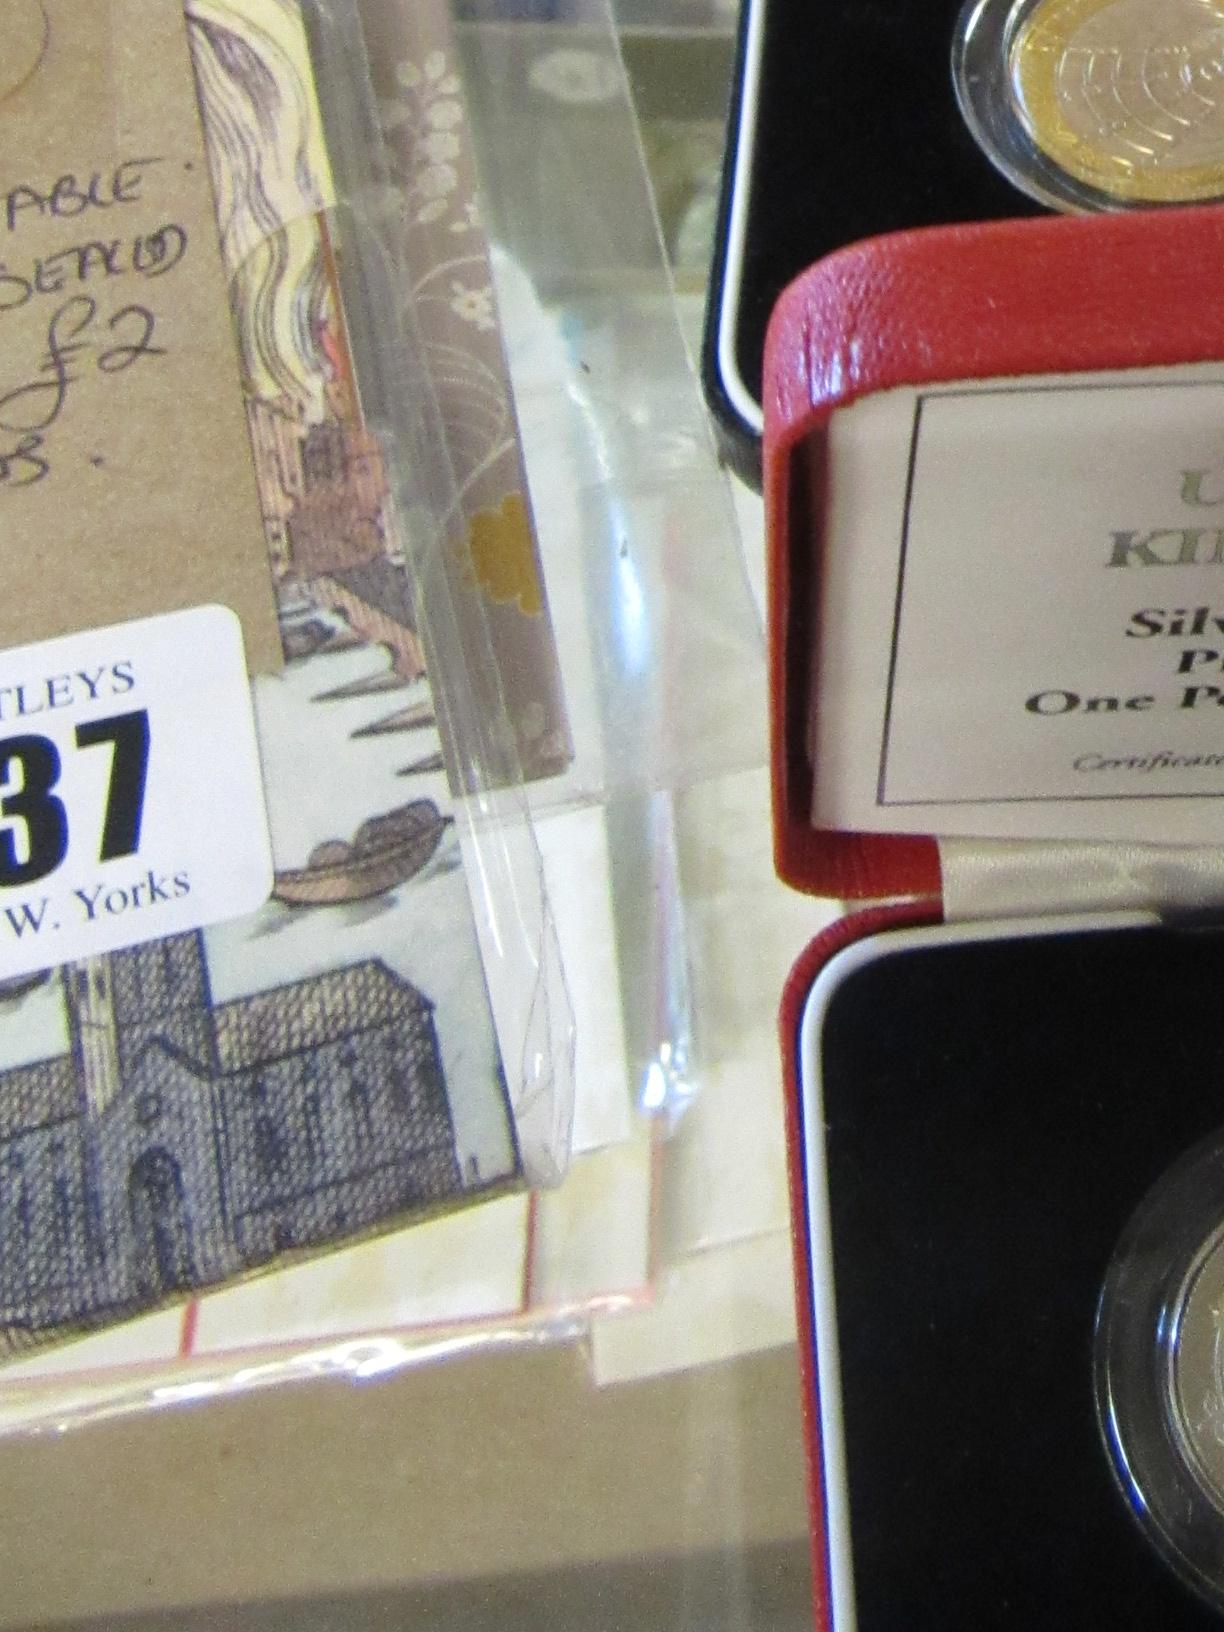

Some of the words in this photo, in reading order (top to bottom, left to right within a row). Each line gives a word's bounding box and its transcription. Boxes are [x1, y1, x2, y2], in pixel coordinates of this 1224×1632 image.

[1024, 688, 1157, 716] One
[3, 900, 61, 941] W.
[73, 869, 193, 924] Yorks
